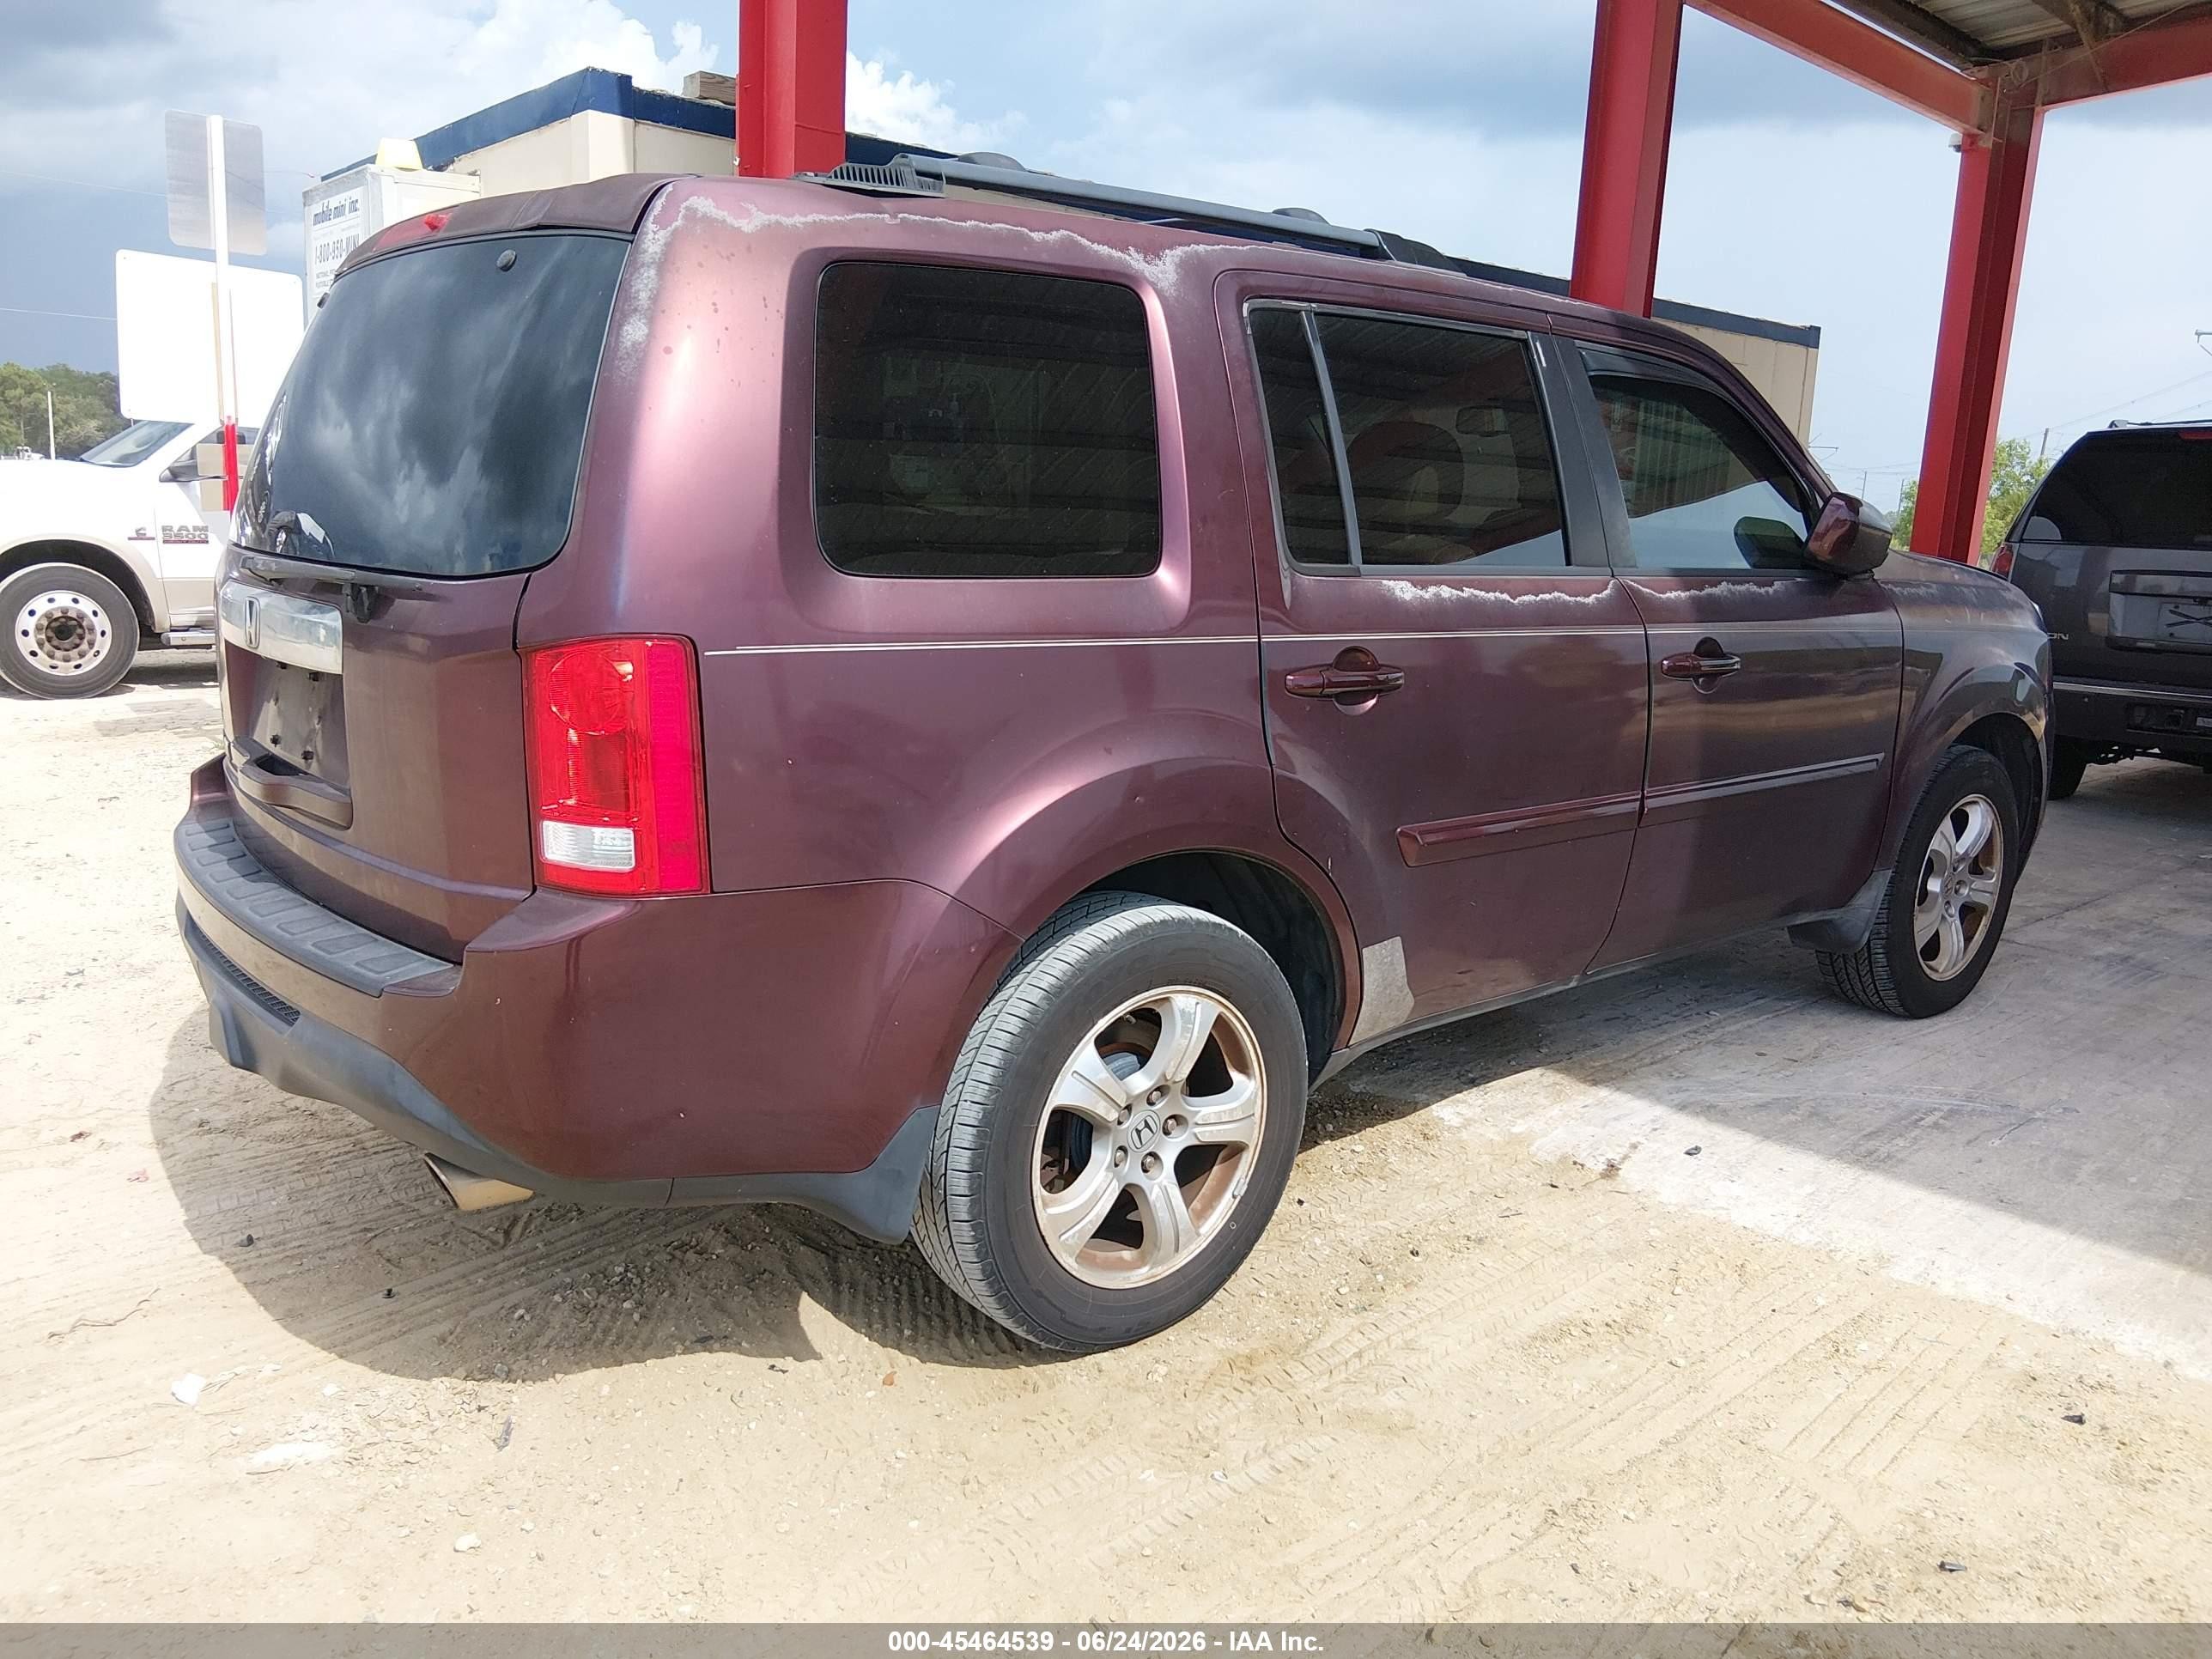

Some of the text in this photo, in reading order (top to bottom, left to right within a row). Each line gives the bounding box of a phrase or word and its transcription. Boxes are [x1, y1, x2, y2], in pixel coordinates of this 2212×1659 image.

[313, 196, 360, 226] mobile mini inc.
